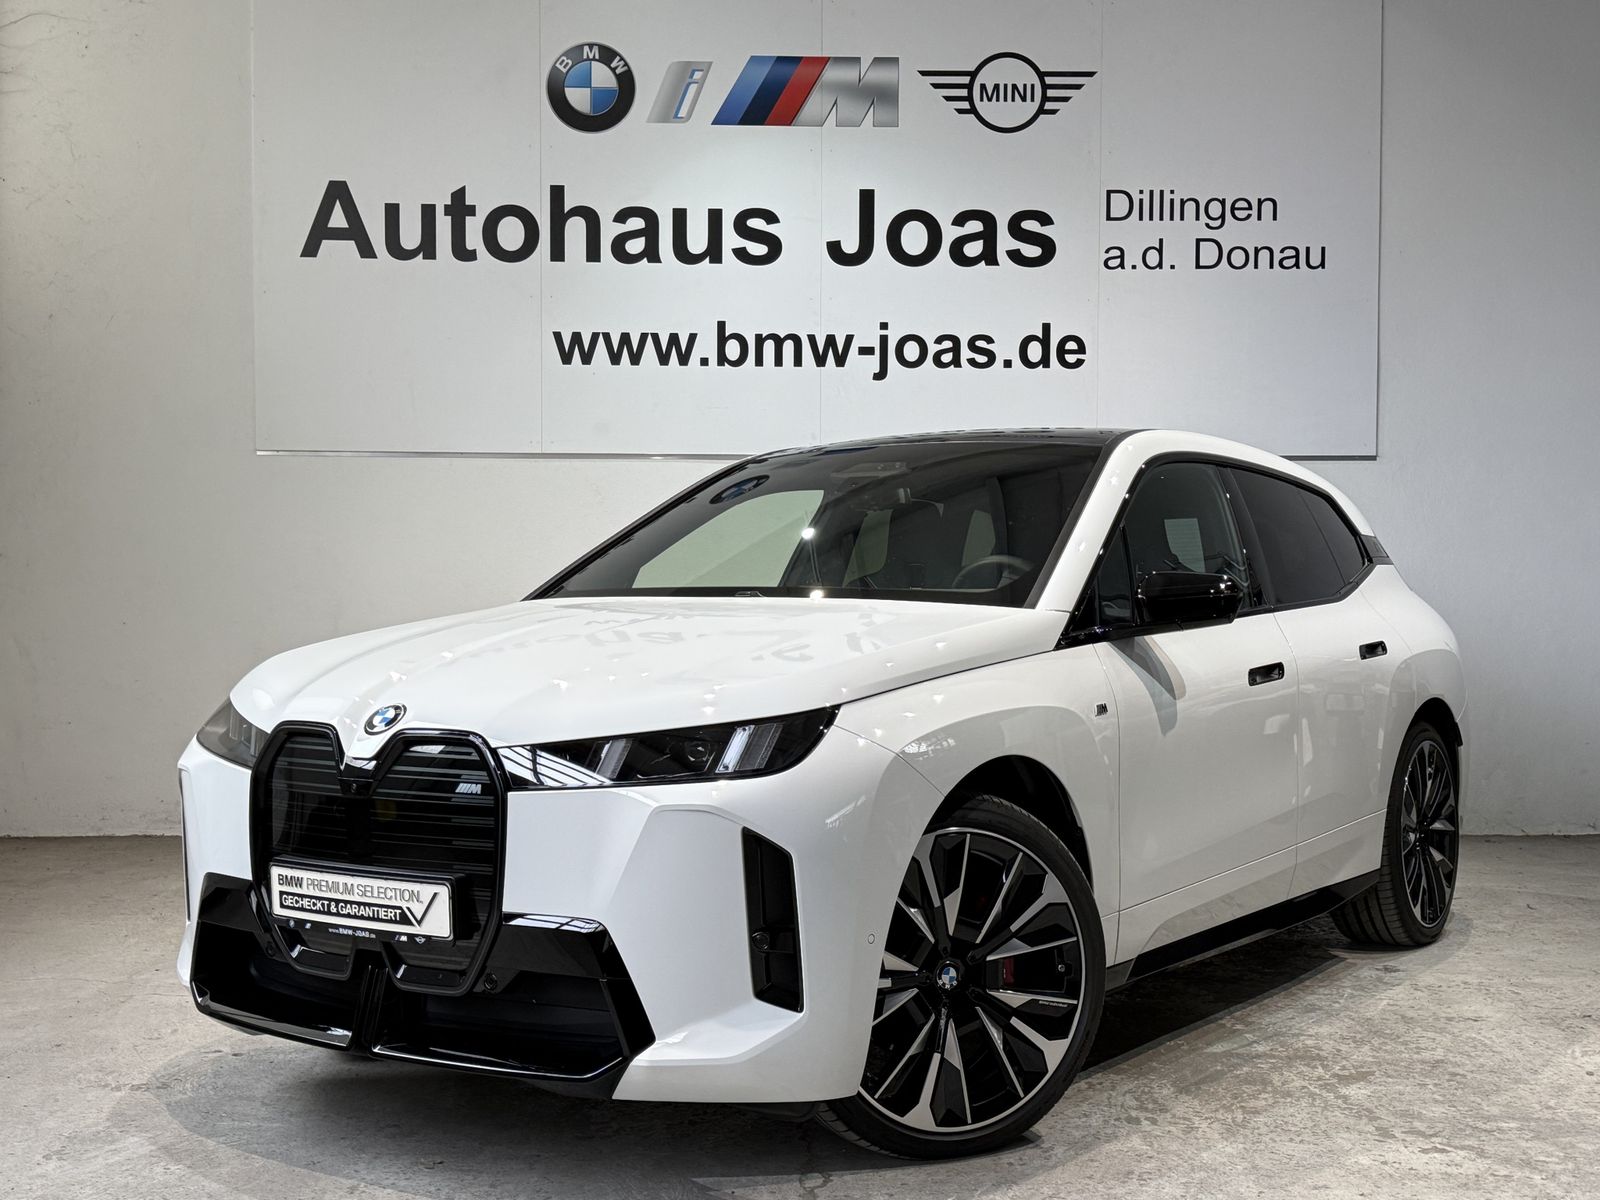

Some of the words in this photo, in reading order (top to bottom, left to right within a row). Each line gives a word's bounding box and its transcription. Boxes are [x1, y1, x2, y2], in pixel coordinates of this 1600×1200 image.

[555, 45, 628, 76] BMW
[979, 83, 1036, 103] MINI
[300, 180, 783, 266] Autohaus
[826, 189, 1057, 268] Joas
[1105, 190, 1278, 229] Dillingen
[1103, 239, 1176, 271] a.d.
[1195, 238, 1327, 271] Donau
[553, 321, 1087, 381] www.bmw-joas.de
[278, 874, 303, 889] BMW
[306, 878, 354, 897] PREMIUM
[282, 894, 329, 912] GECHECKT
[330, 901, 337, 913] &
[338, 905, 402, 921] GARANTIERT
